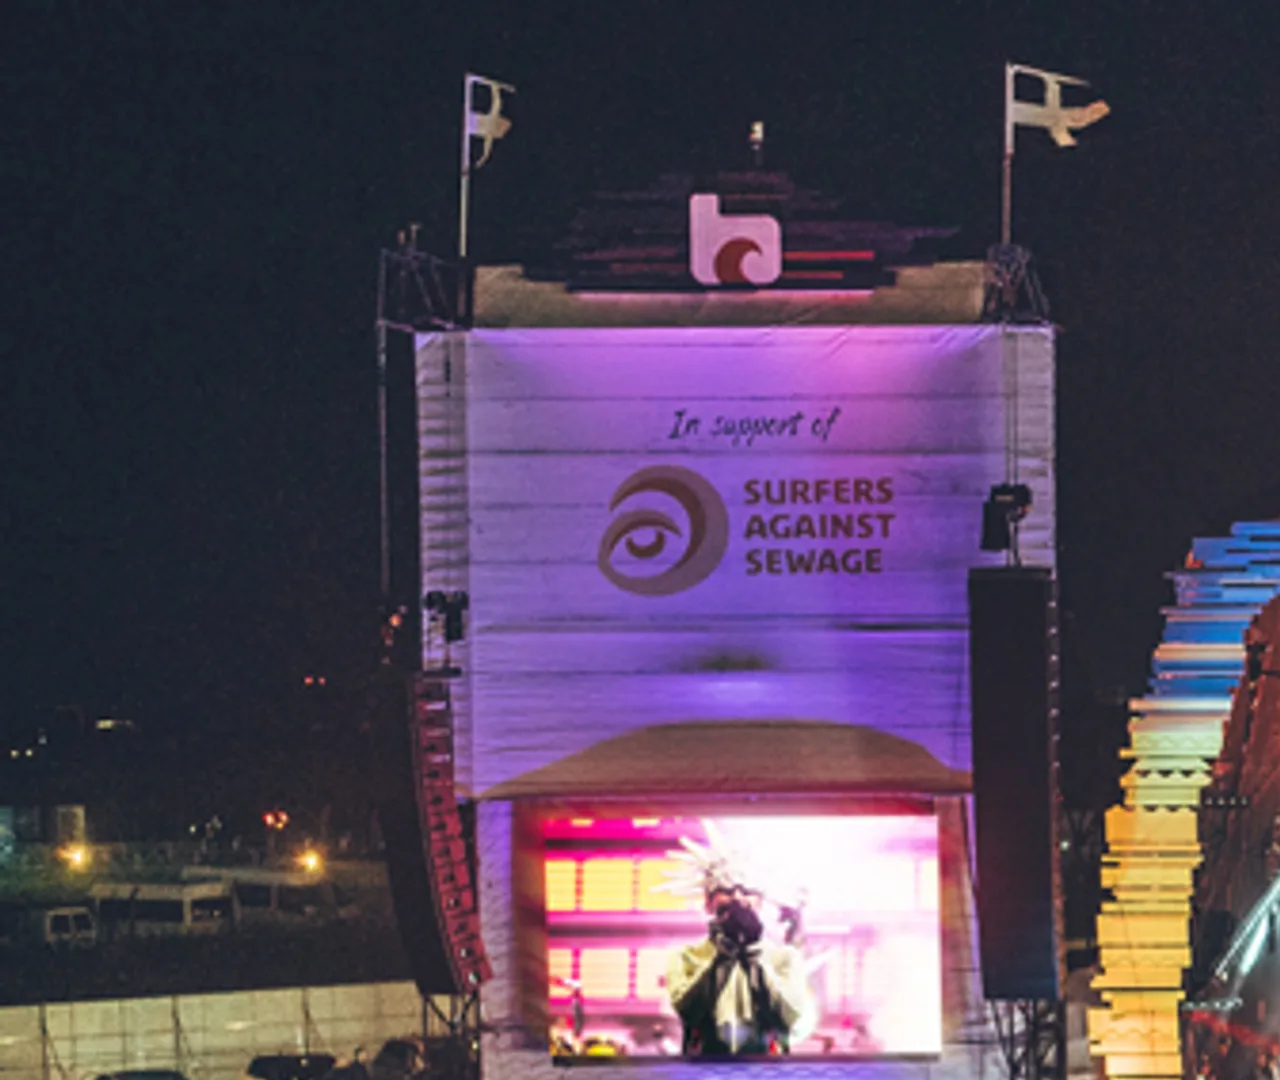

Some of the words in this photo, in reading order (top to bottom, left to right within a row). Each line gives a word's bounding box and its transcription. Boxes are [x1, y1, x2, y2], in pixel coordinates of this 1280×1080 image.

[668, 409, 701, 440] In
[710, 412, 804, 447] support
[811, 406, 842, 442] of
[744, 477, 895, 504] SURFERS
[744, 512, 896, 540] AGAINST
[744, 548, 883, 575] SEWAGE
